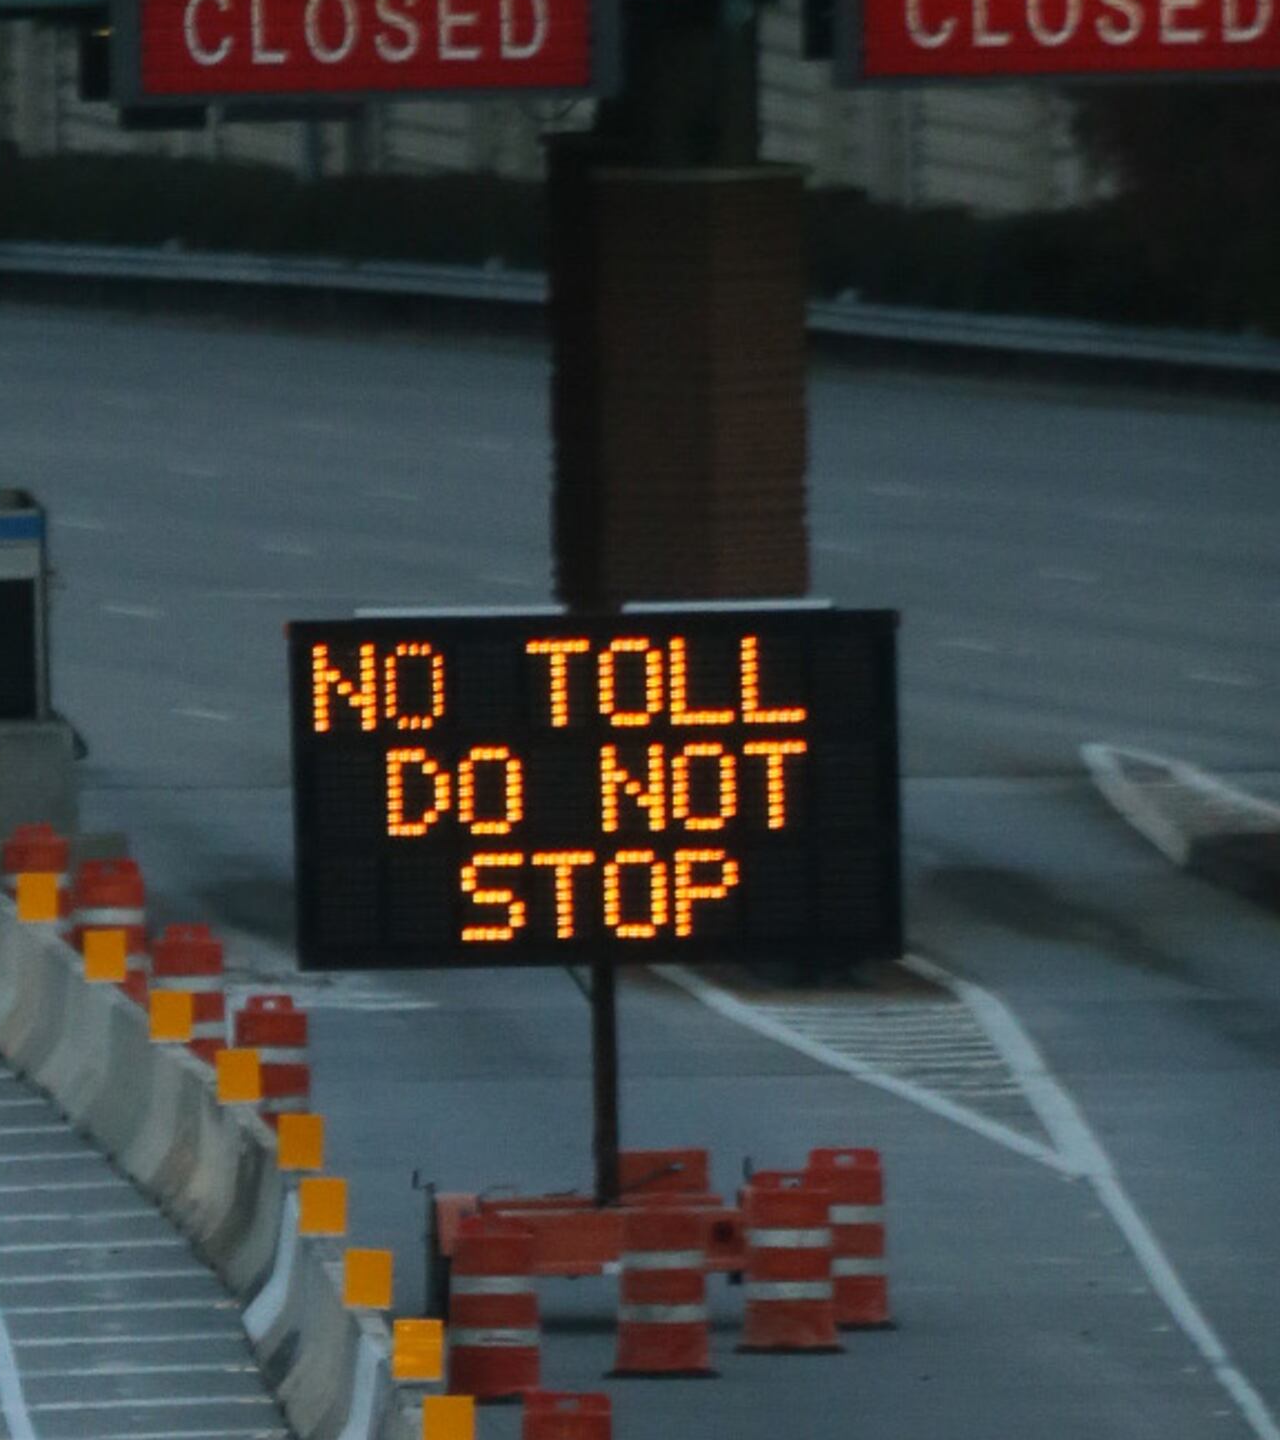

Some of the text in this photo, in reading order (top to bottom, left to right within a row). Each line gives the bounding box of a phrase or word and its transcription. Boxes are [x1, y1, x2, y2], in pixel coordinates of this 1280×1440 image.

[311, 635, 807, 733] NO TOLL
[386, 740, 807, 837] DO NOT
[460, 849, 739, 942] STOP
